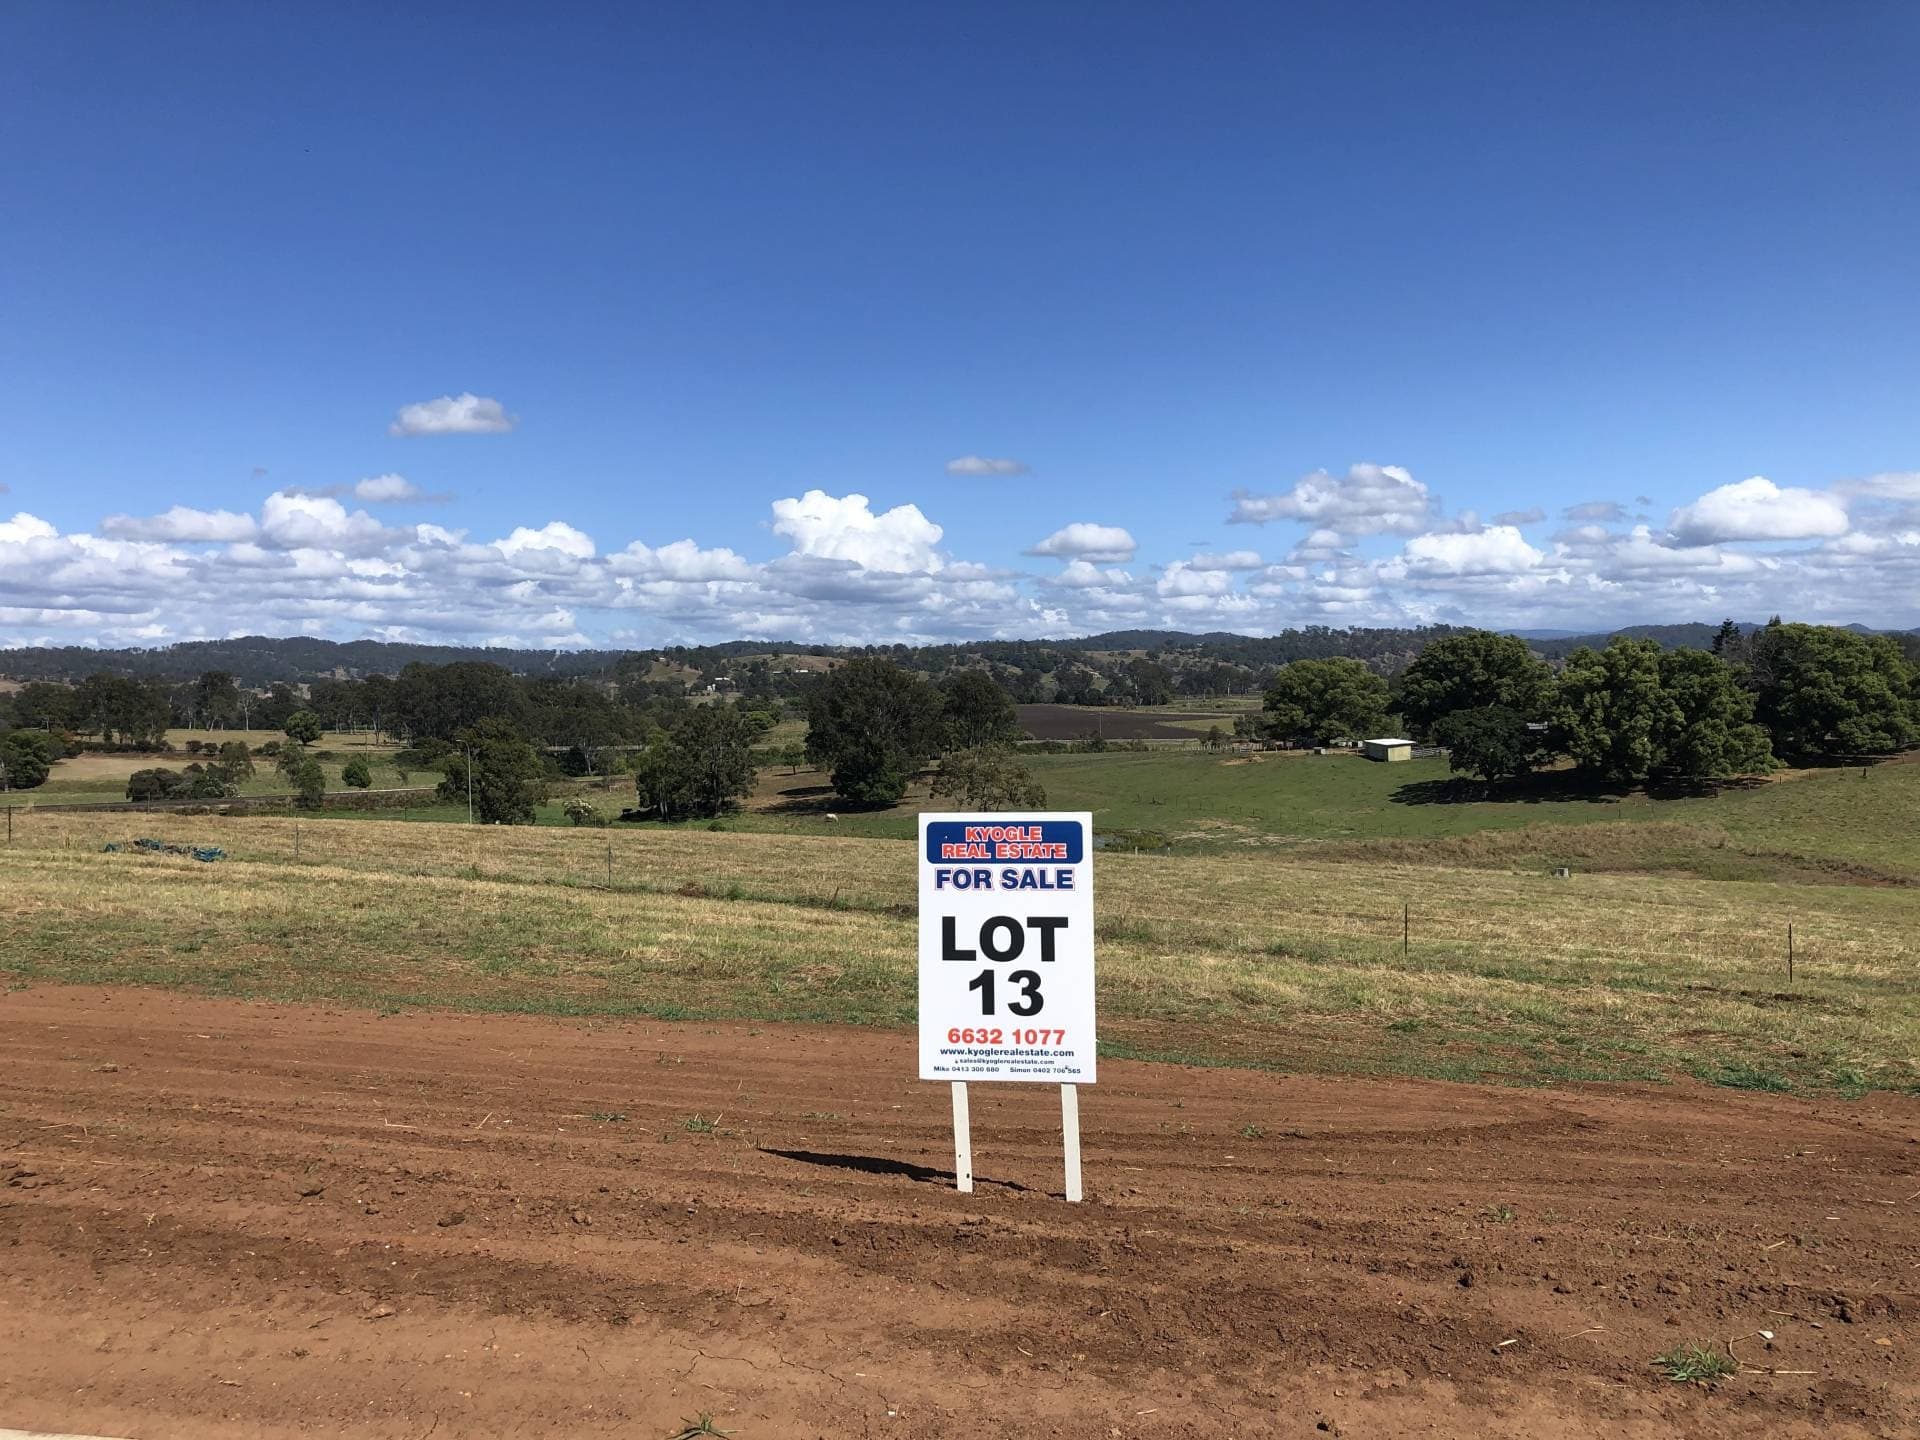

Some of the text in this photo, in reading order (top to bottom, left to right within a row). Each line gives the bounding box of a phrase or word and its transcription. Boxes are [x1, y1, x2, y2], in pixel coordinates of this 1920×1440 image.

[965, 826, 1042, 842] KYOGLE
[942, 843, 1067, 859] REAL ESTATE
[935, 867, 1075, 891] FOR SALE
[942, 915, 1069, 962] LOT
[969, 969, 1044, 1017] 13
[947, 1028, 1066, 1045] 6632 1077
[940, 1047, 1075, 1057] www.kyoglerealestate.com
